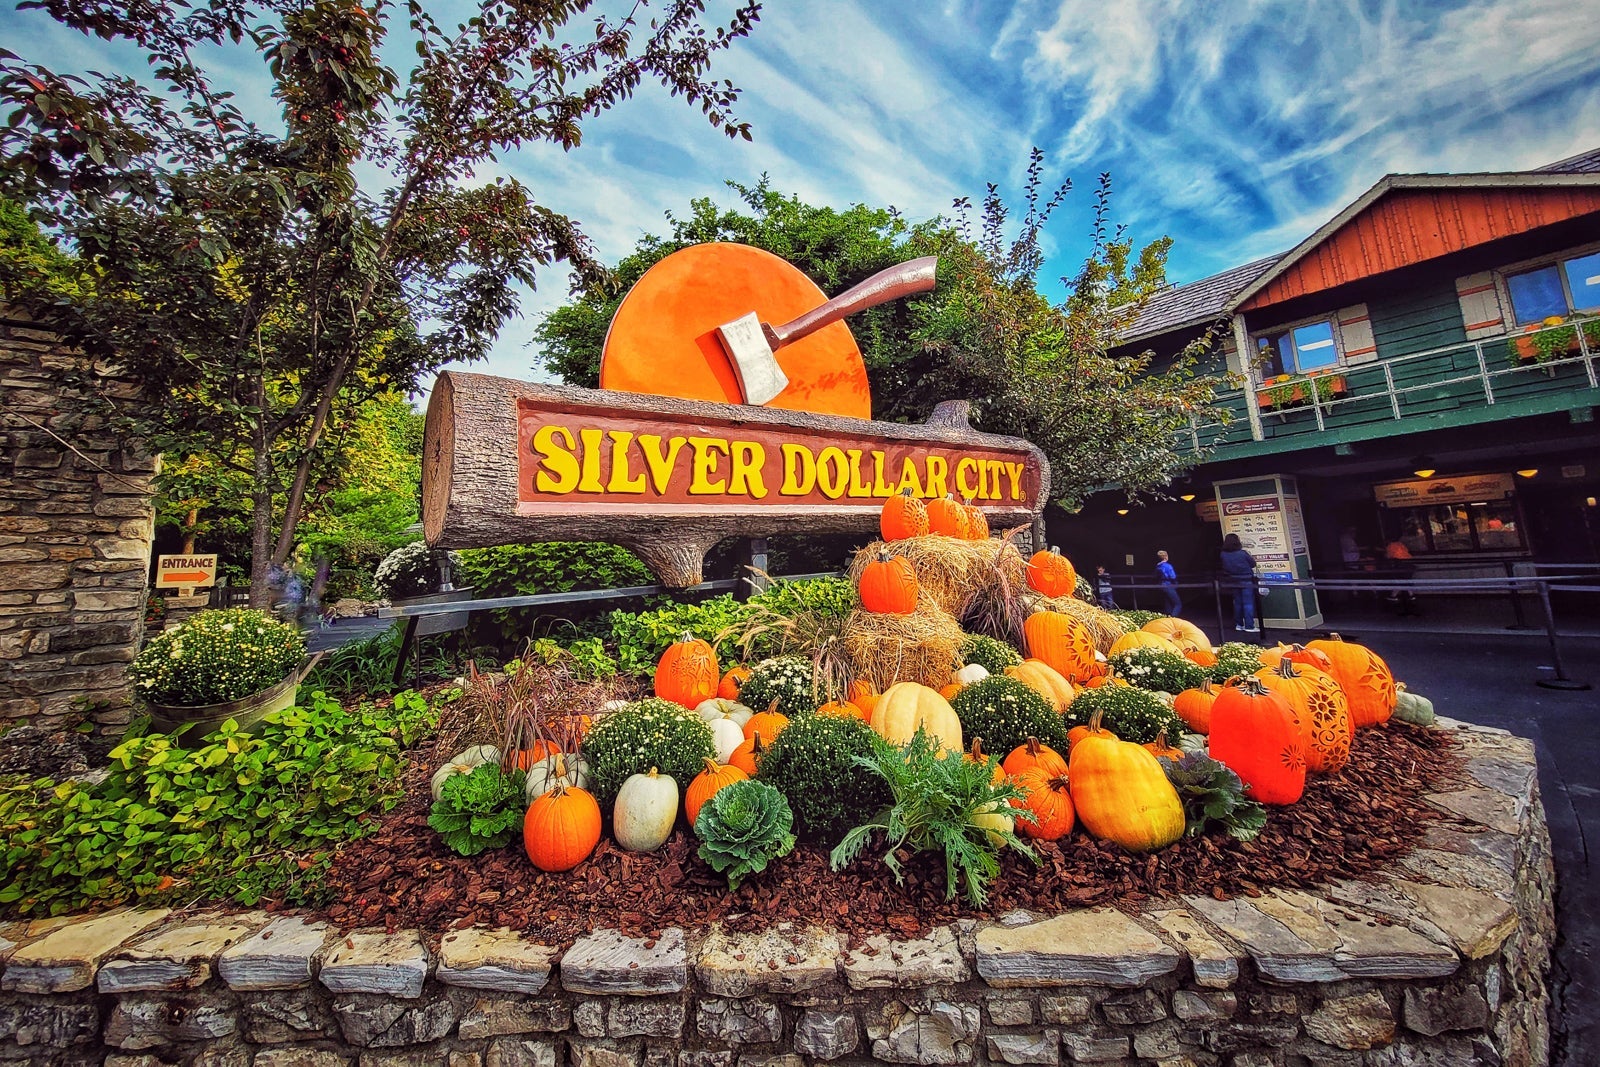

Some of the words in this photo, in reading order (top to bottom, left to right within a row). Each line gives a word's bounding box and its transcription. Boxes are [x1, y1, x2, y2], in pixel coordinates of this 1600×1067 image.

[533, 425, 768, 499] SILVER
[780, 443, 949, 499] DOLLAR
[955, 457, 1024, 500] CITY
[162, 558, 213, 568] ENTRANCE
